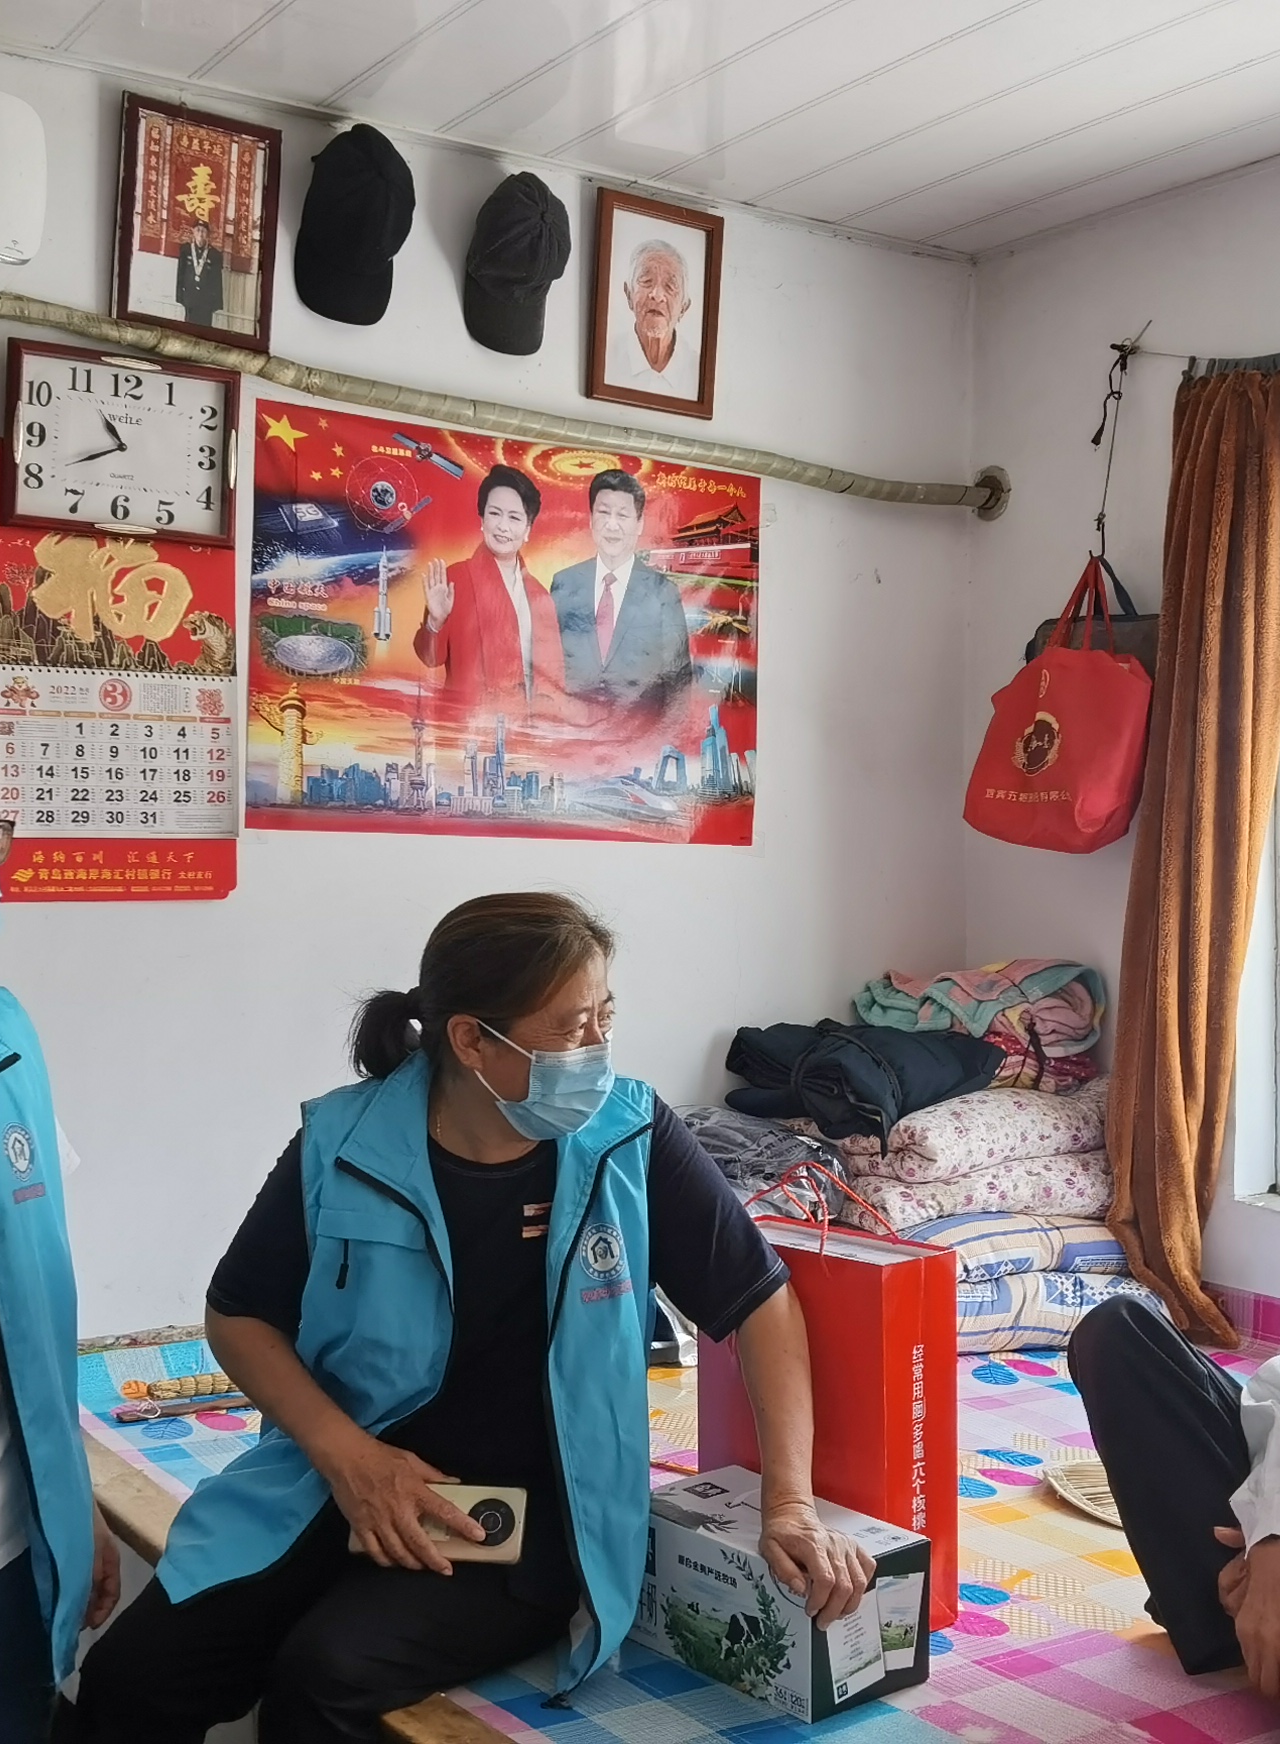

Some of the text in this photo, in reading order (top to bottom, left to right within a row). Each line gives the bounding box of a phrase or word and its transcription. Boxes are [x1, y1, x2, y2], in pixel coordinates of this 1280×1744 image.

[67, 366, 95, 394] 11
[110, 373, 144, 401] 12
[25, 380, 53, 408] 10
[165, 382, 176, 407] 1
[199, 405, 218, 431] 2
[26, 421, 47, 448] 9
[197, 445, 217, 471] 3
[23, 462, 44, 490] 8
[64, 487, 85, 515] 7
[110, 494, 131, 521] 6
[196, 486, 215, 512] 4
[155, 500, 175, 526] 5
[293, 505, 320, 520] 5G
[33, 530, 193, 643] 福
[48, 685, 77, 696] 2022
[106, 683, 127, 705] 3
[76, 722, 220, 740] 1 2 3 4 5
[5, 742, 225, 762] 6 7 8 9 10 11 12
[2, 764, 225, 783] 13 14 15 16 17 18 19
[1, 787, 226, 804] 20 21 22 23 24 25 26
[2, 809, 157, 825] 27 28 29 30 31
[32, 850, 196, 864] 海纳百川 汇通天下
